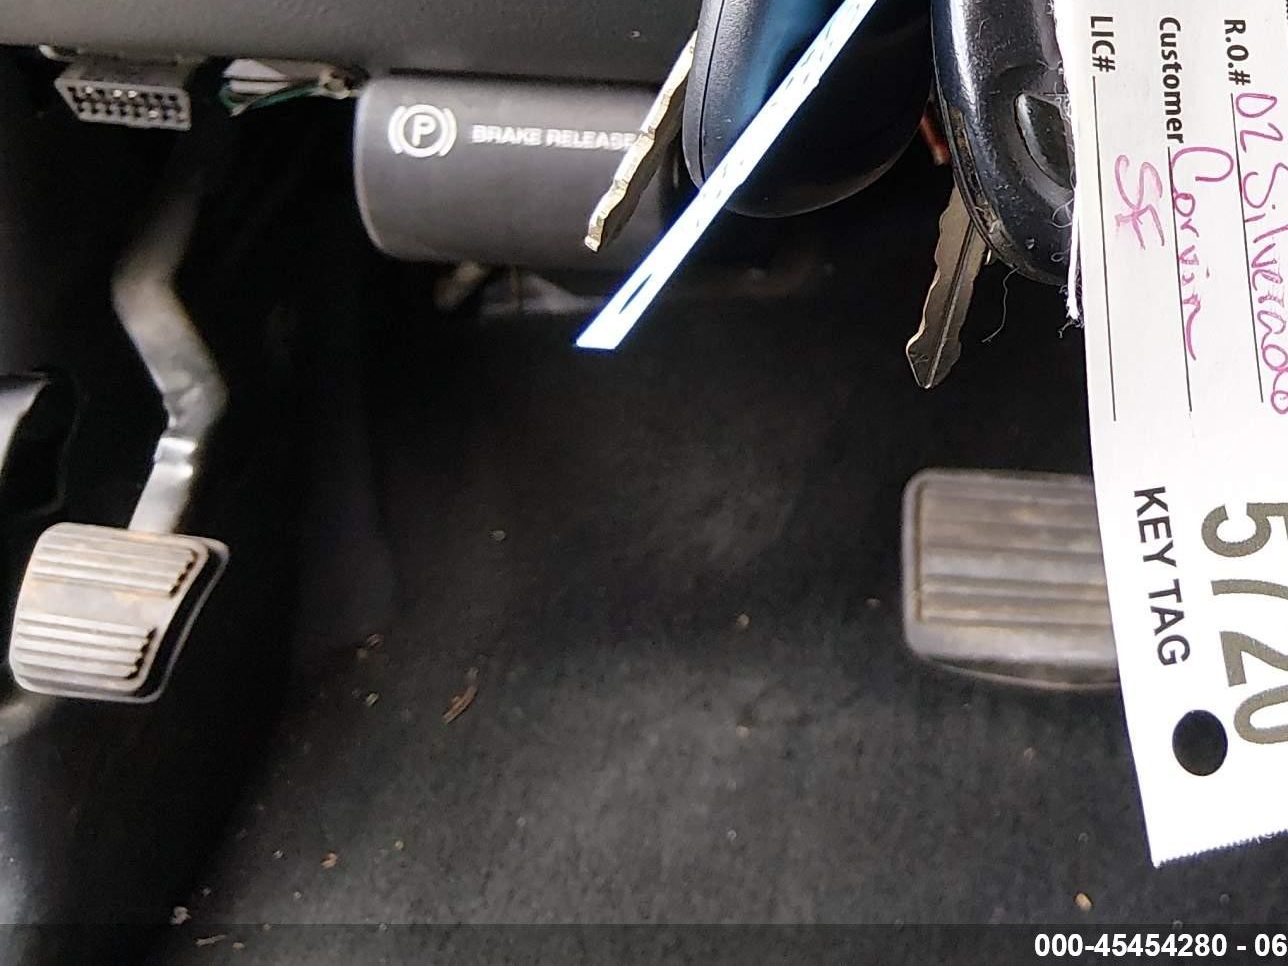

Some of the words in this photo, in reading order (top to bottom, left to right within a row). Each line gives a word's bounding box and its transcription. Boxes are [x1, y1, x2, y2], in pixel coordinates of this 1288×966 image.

[1090, 15, 1116, 73] LIC#
[1159, 17, 1185, 144] Customer
[1224, 19, 1251, 86] R.O.#
[471, 124, 542, 146] BRAKE
[545, 129, 638, 151] RELEASE
[1133, 486, 1177, 568] KEY
[1148, 578, 1191, 666] TAG
